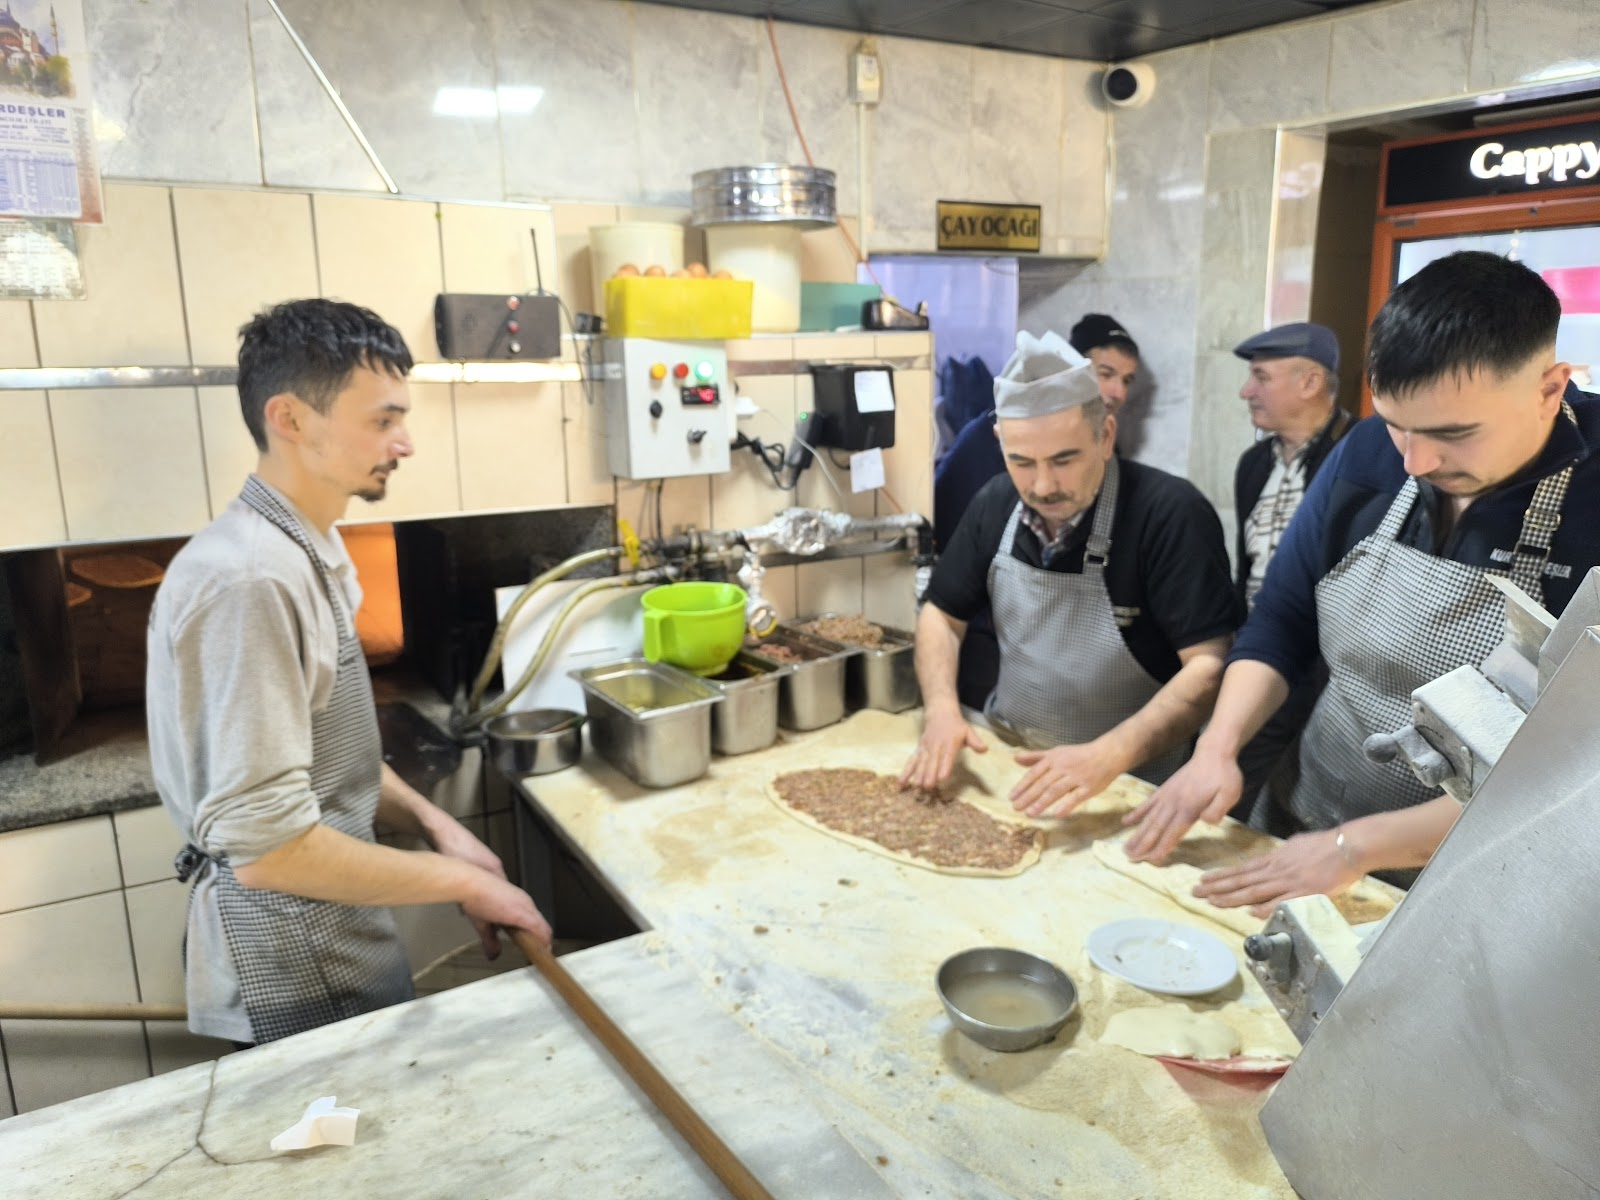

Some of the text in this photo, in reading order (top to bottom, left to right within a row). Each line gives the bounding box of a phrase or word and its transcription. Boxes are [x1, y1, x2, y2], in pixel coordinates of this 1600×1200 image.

[1469, 141, 1600, 185] Cappy
[941, 213, 1038, 239] ÇAY OCAĞI
[1489, 547, 1513, 564] KUR
